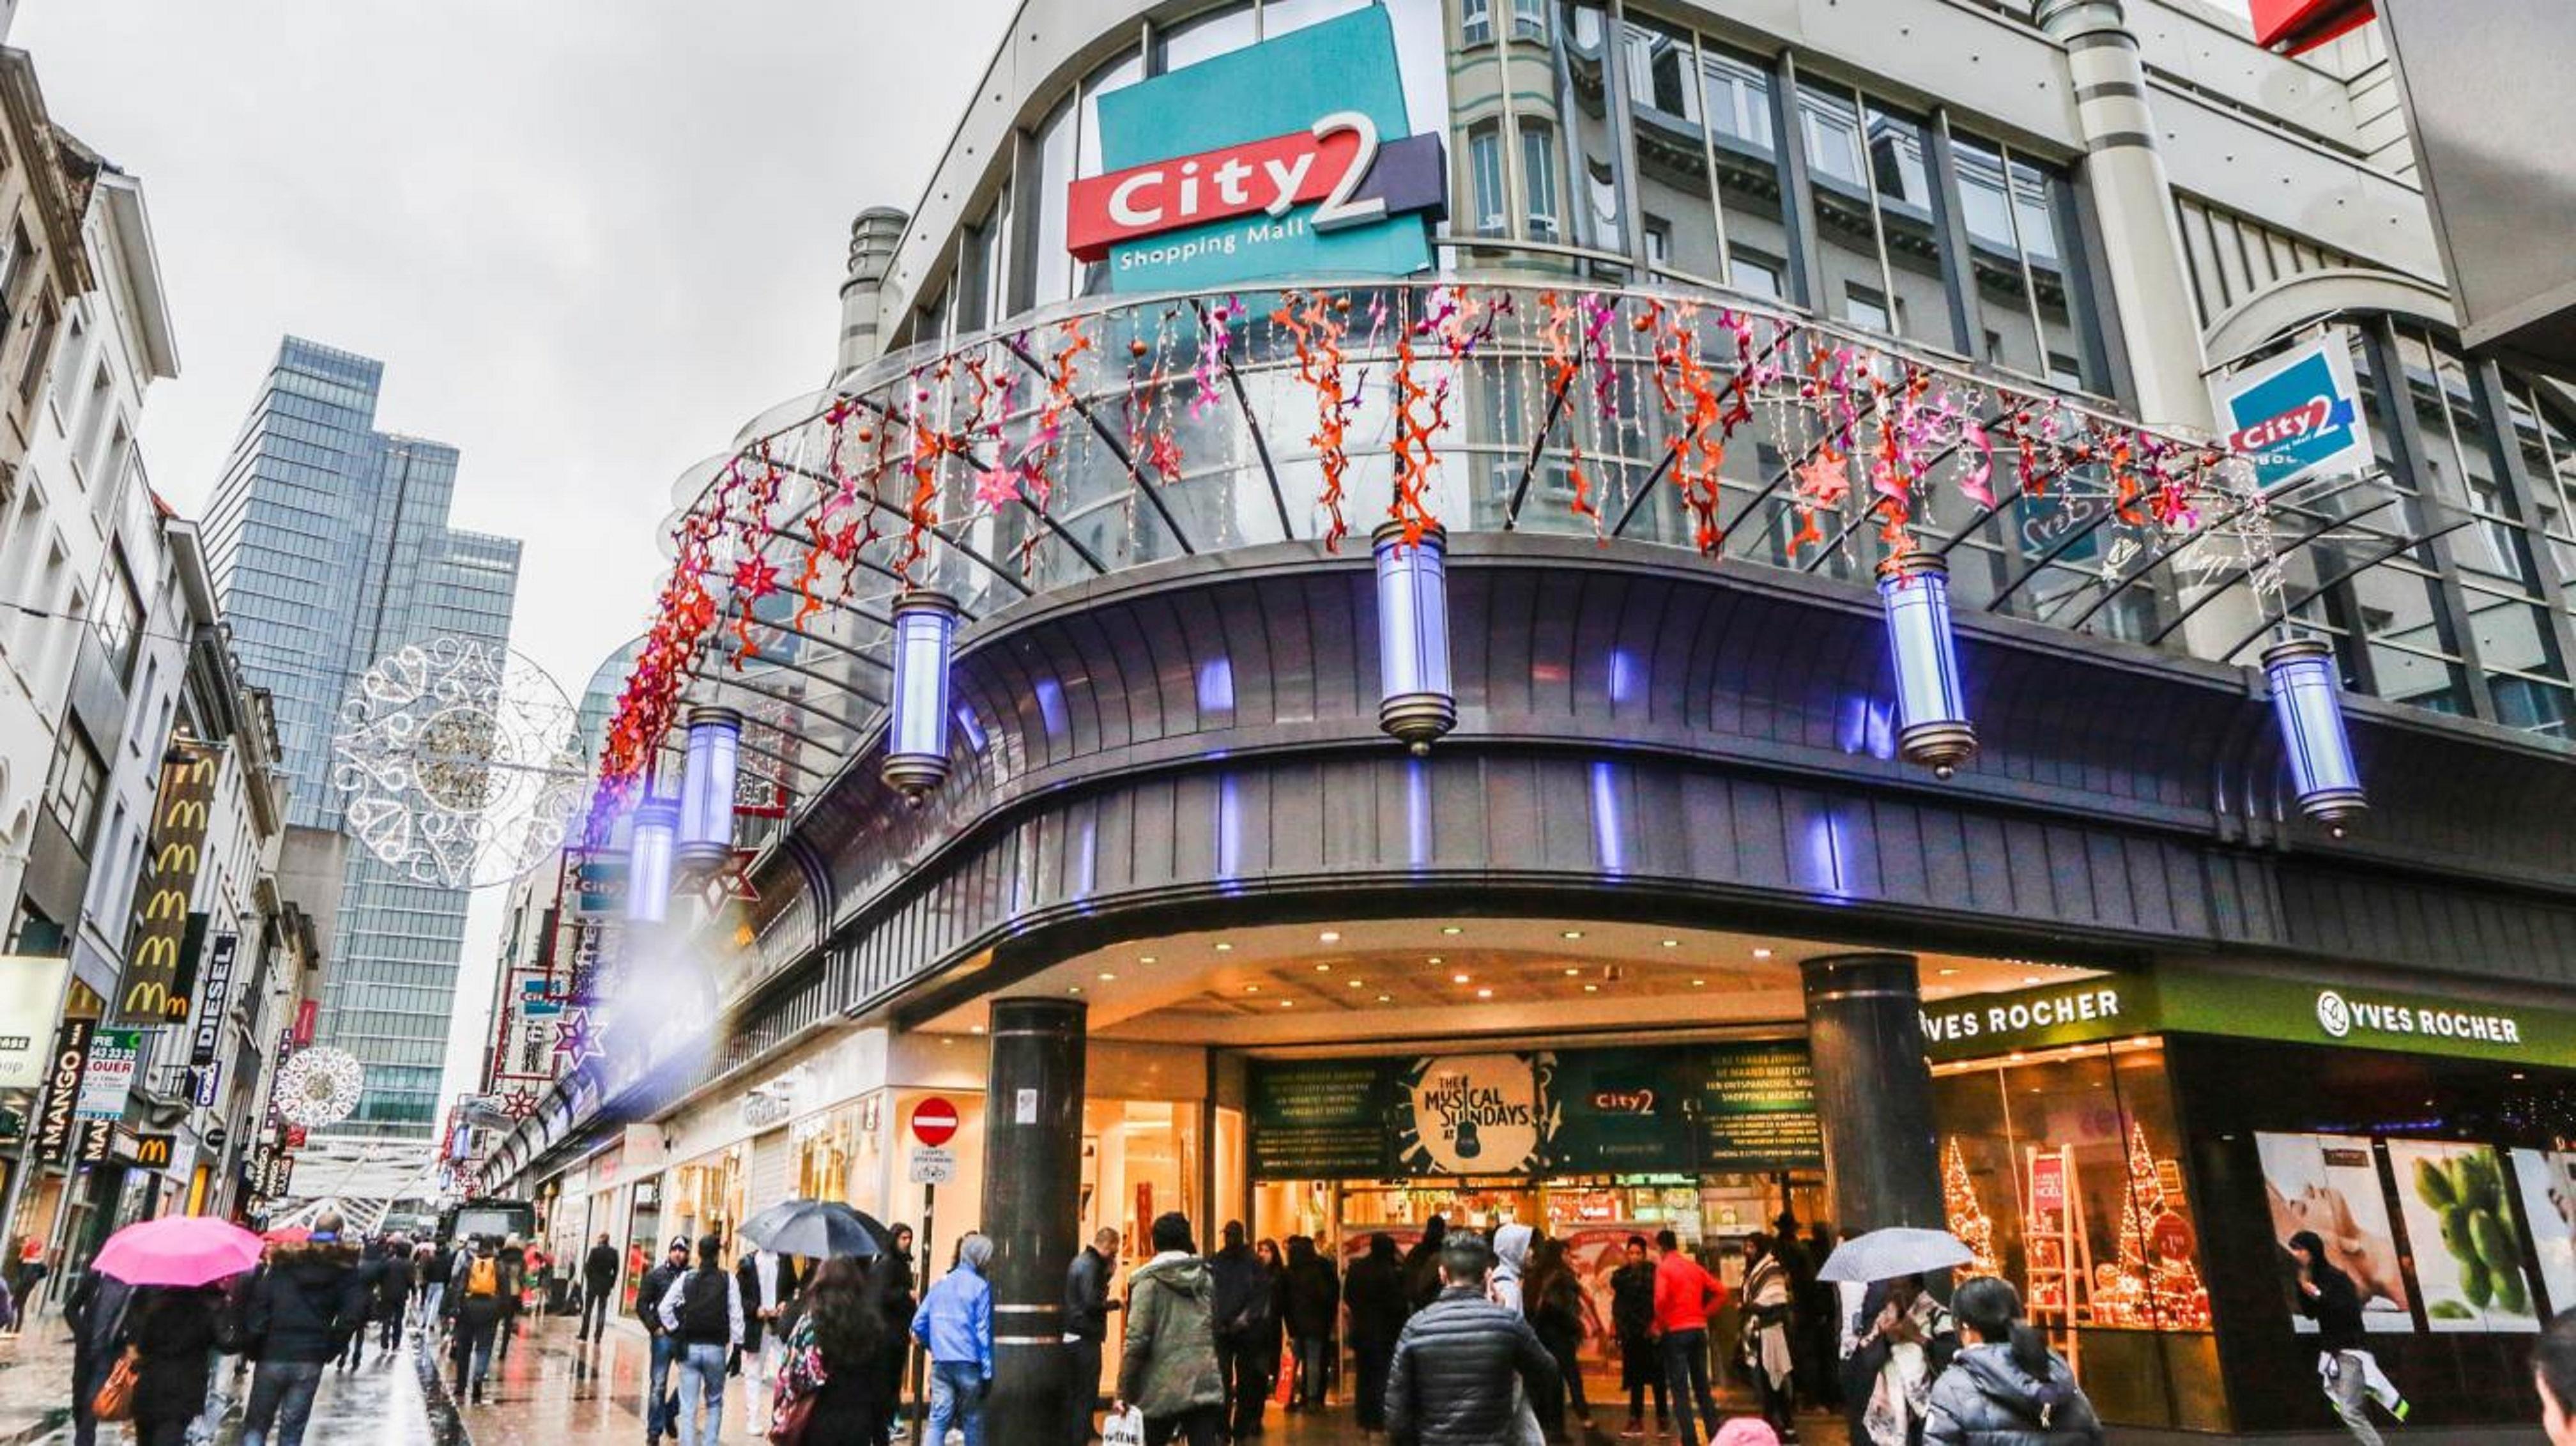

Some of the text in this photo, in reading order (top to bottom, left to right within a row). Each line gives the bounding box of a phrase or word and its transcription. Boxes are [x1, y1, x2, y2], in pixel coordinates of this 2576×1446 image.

[1120, 219, 1303, 270] Shopping Mall
[197, 946, 232, 1047] DIESEL
[1988, 990, 2119, 1033] ROCHER
[2350, 1001, 2520, 1043] YVES ROCHER
[88, 1061, 131, 1073] OUER
[1439, 1077, 1459, 1088] THE
[43, 1051, 80, 1144] MANGO
[1440, 1104, 1528, 1127] SUNDAYS
